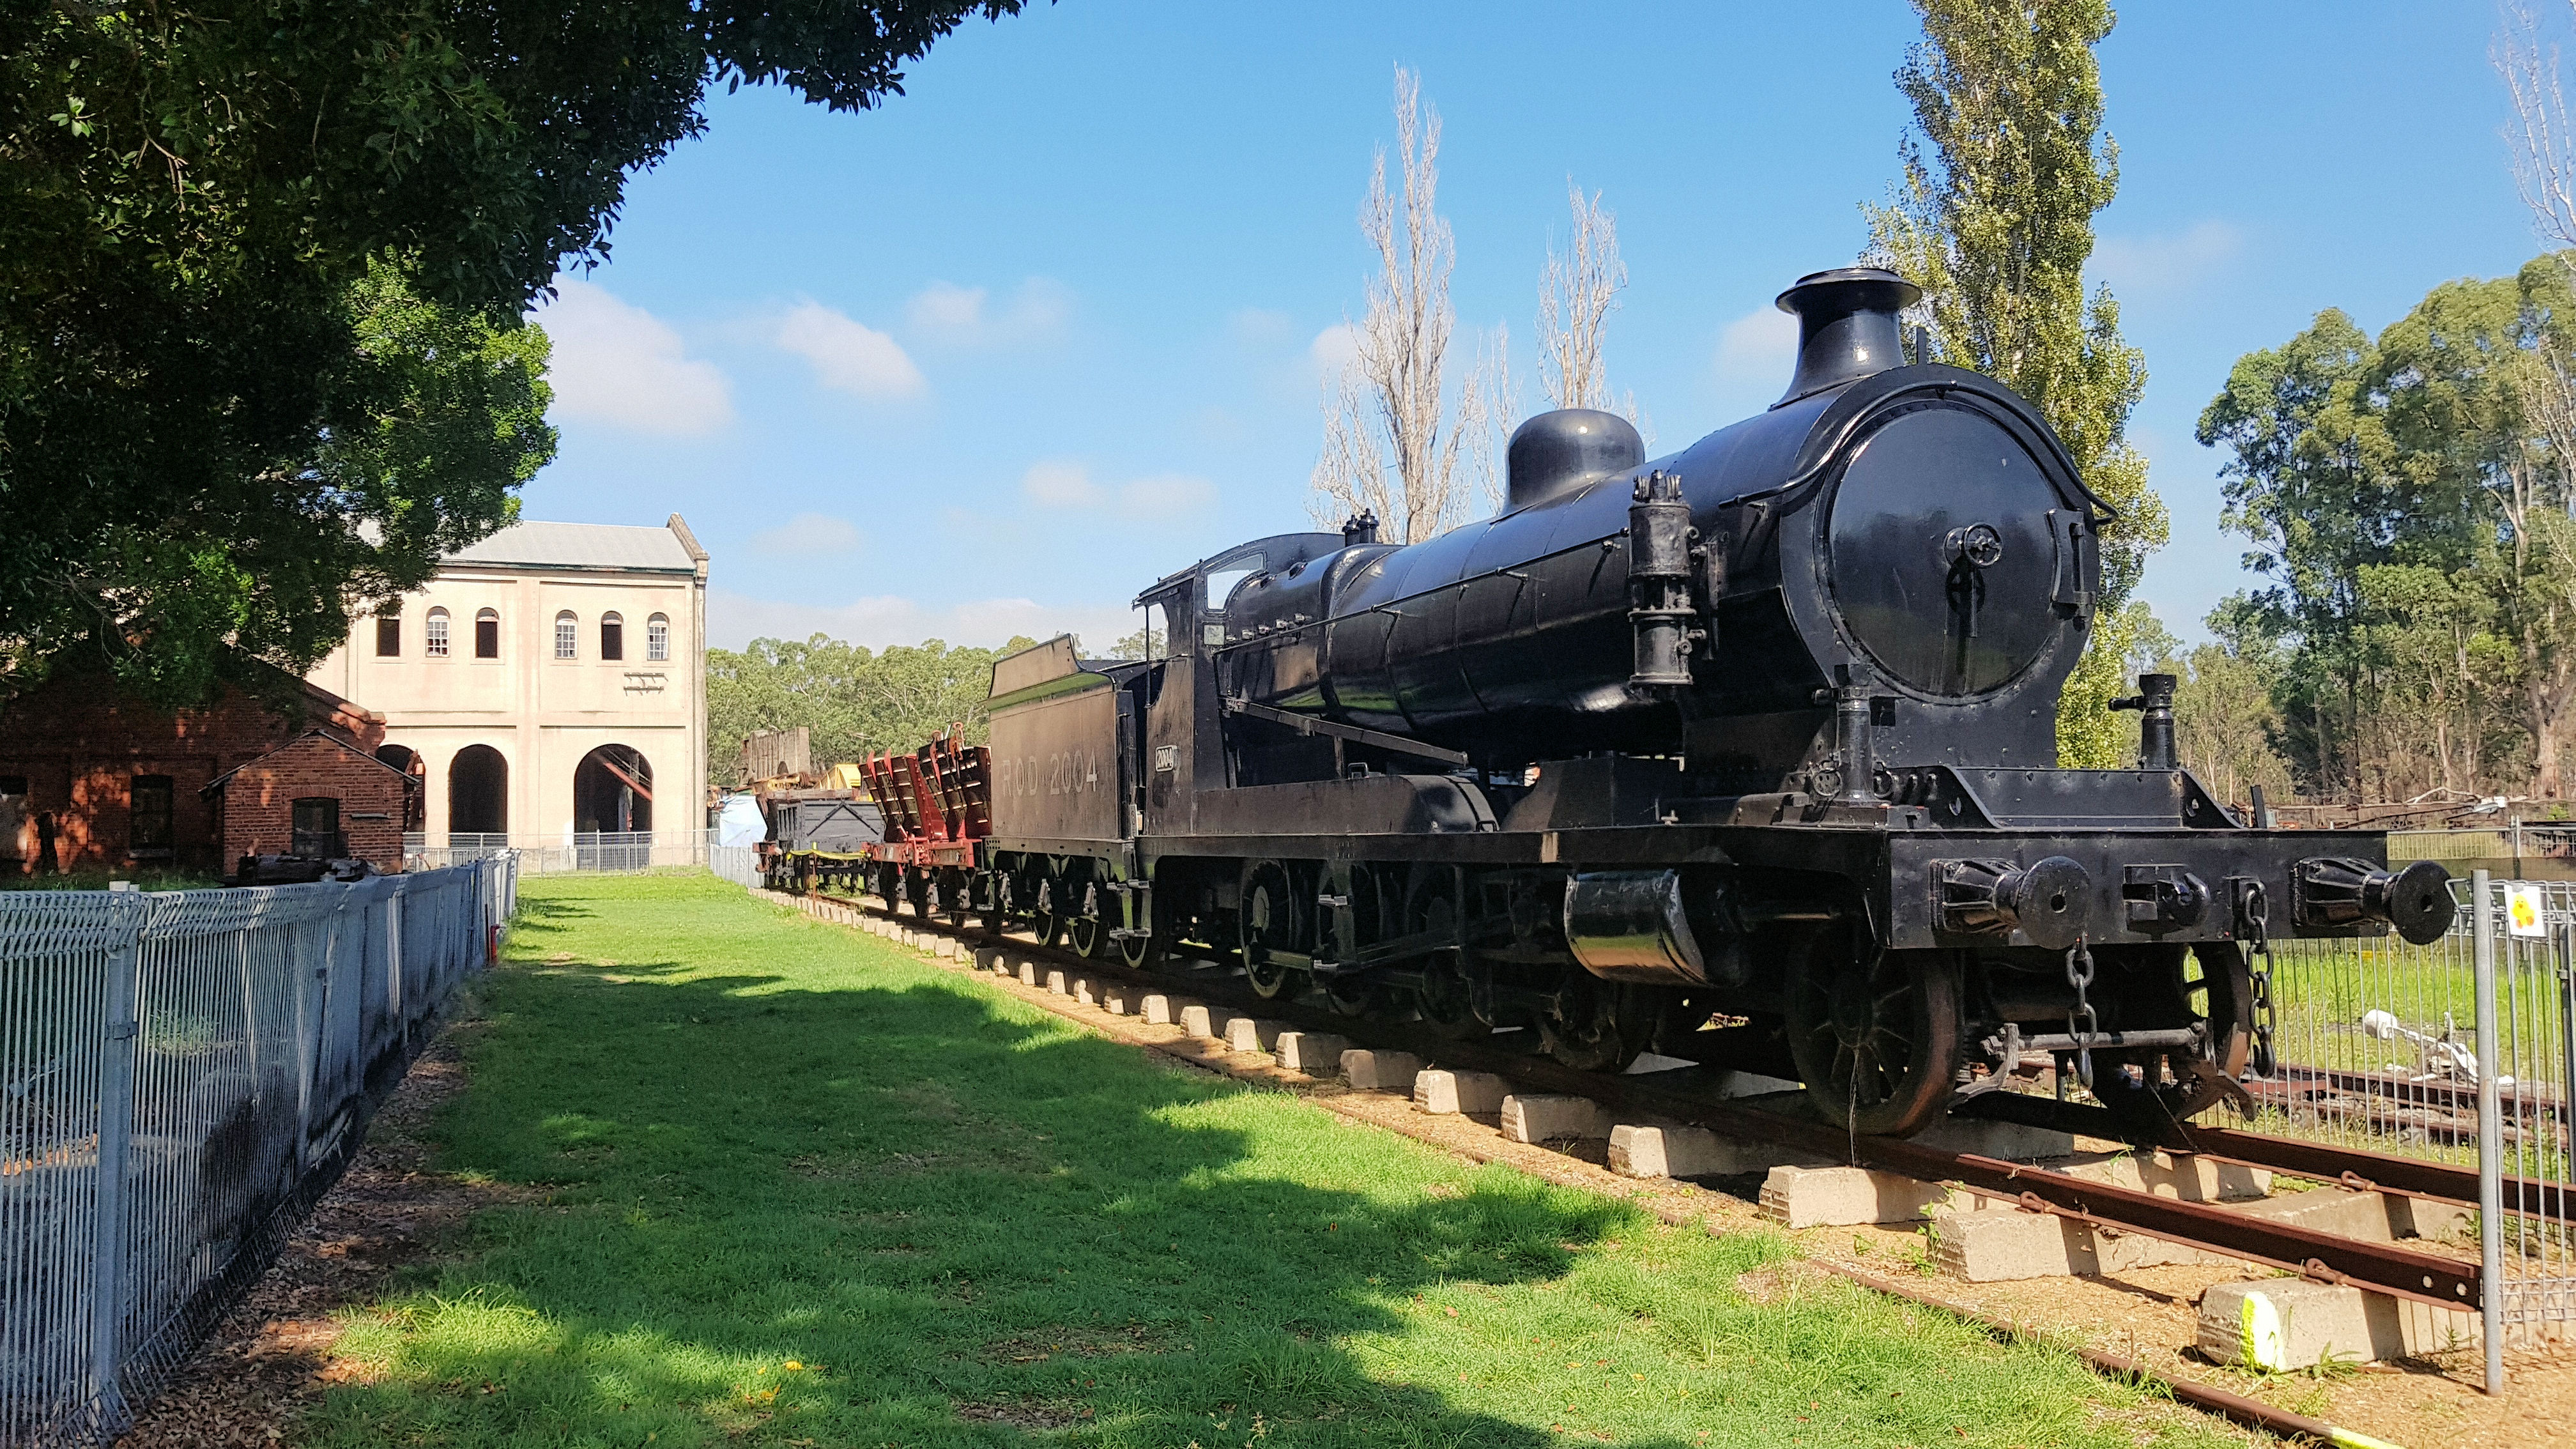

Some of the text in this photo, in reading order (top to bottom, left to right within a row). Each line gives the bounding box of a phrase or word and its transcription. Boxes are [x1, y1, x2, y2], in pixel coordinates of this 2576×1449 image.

[1002, 747, 1098, 798] ROD 2004
[1157, 747, 1173, 768] 2004
